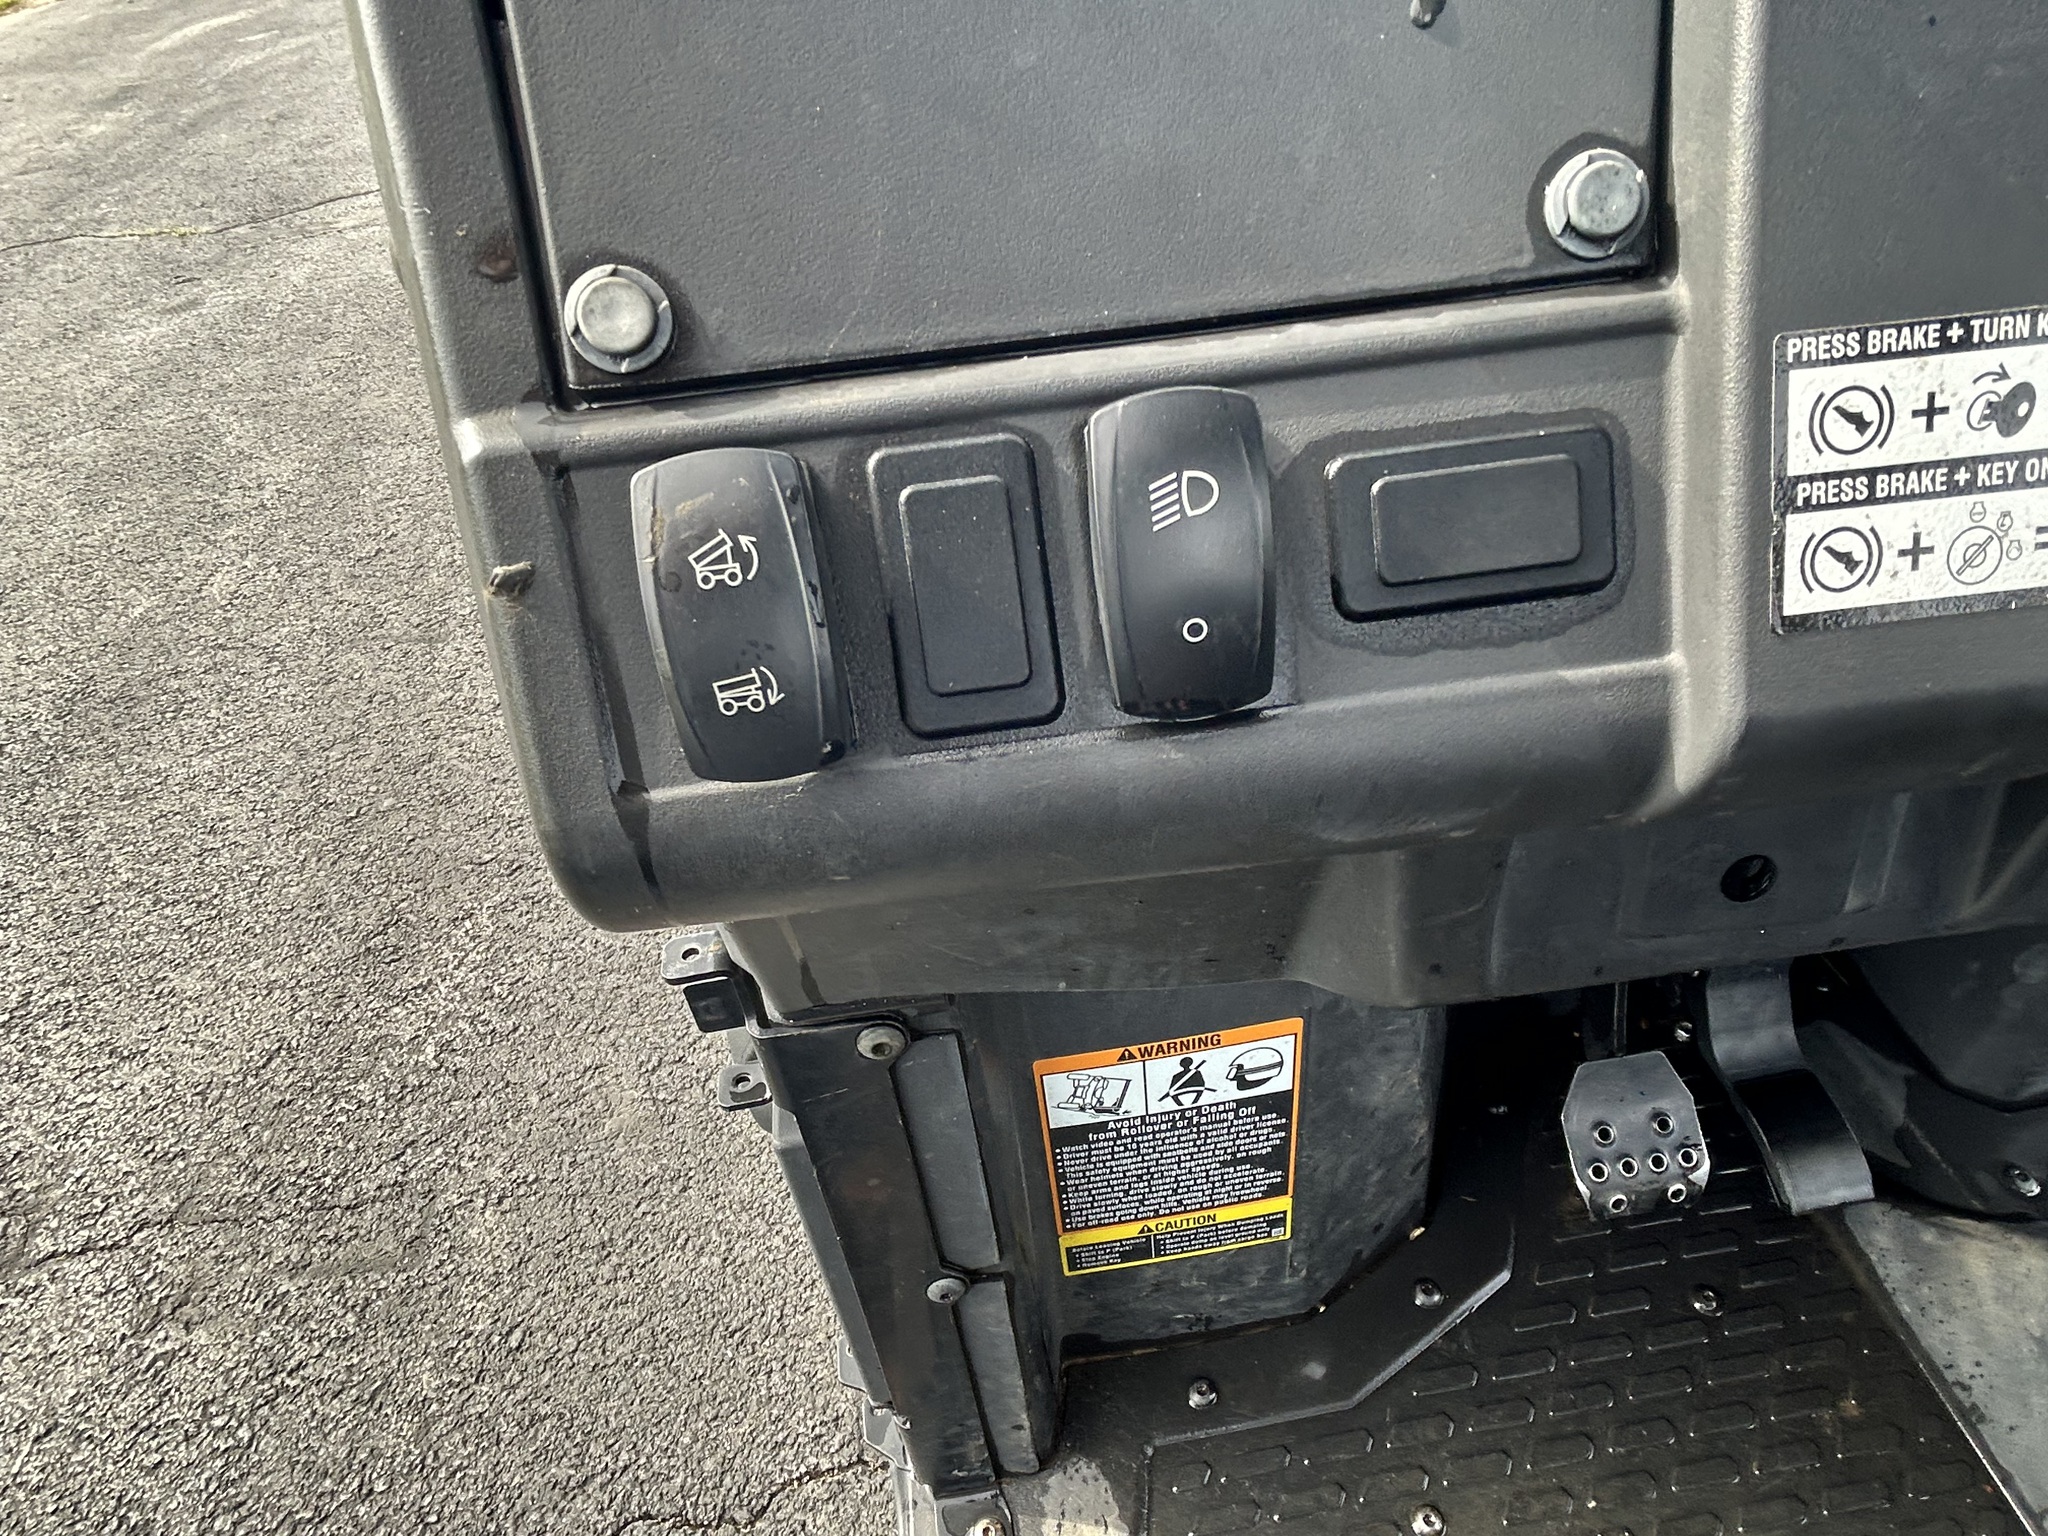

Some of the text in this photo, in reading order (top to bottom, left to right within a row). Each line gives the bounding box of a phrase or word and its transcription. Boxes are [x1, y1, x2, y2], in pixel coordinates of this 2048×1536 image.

[1787, 330, 1861, 363] PRESS
[1867, 323, 1941, 354] BRAKE
[1970, 314, 2031, 343] TURN
[1796, 476, 1869, 507] PRESS
[1875, 468, 1948, 498] BRAKE
[1977, 460, 2019, 487] KEY
[1137, 1034, 1221, 1058] WARNING
[1088, 1106, 1256, 1142] from Rollover or Falling Off
[1107, 1101, 1236, 1130] Avoid Injury or Death
[1061, 1143, 1088, 1153] Watch
[1090, 1139, 1113, 1149] video
[1116, 1136, 1131, 1145] and
[1133, 1133, 1152, 1142] read
[1155, 1125, 1197, 1139] operator's
[1199, 1120, 1230, 1131] manual
[1233, 1115, 1258, 1125] before
[1062, 1150, 1088, 1160] Driver
[1091, 1147, 1111, 1155] must
[1139, 1138, 1162, 1148] years
[1180, 1132, 1197, 1140] with
[1207, 1127, 1227, 1136] valid
[1230, 1123, 1254, 1132] driver
[1063, 1158, 1088, 1167] Never
[1090, 1154, 1111, 1162] drive
[1113, 1149, 1137, 1158] under
[1155, 1140, 1193, 1152] influence
[1206, 1133, 1236, 1143] alcohol
[1066, 1171, 1083, 1179] This
[1085, 1167, 1110, 1177] safety
[1112, 1159, 1156, 1173] equipment
[1158, 1156, 1178, 1164] must
[1193, 1150, 1212, 1158] used
[1066, 1177, 1088, 1186] Wear
[1090, 1171, 1123, 1182] helmets
[1125, 1167, 1147, 1176] when
[1149, 1162, 1177, 1173] driving
[1248, 1147, 1271, 1157] rough
[1077, 1182, 1107, 1191] uneven
[1163, 1167, 1188, 1177] higher
[1068, 1190, 1088, 1199] Keep
[1130, 1180, 1148, 1189] legs
[1150, 1176, 1174, 1185] inside
[1177, 1171, 1206, 1180] vehicle
[1208, 1166, 1234, 1176] during
[1069, 1196, 1092, 1205] While
[1128, 1187, 1149, 1195] drive
[1151, 1182, 1177, 1192] slowly
[1069, 1203, 1091, 1211] Drive
[1093, 1198, 1119, 1208] slowly
[1121, 1194, 1142, 1202] when
[1189, 1182, 1212, 1192] rough
[1225, 1176, 1253, 1185] uneven
[1087, 1217, 1118, 1226] off-road
[1214, 1196, 1237, 1206] public
[1088, 1211, 1113, 1220] brakes
[1115, 1207, 1136, 1217] going
[1138, 1204, 1159, 1212] down
[1182, 1195, 1210, 1205] Vehicle
[1212, 1192, 1227, 1200] may
[1155, 1213, 1217, 1232] CAUTION
